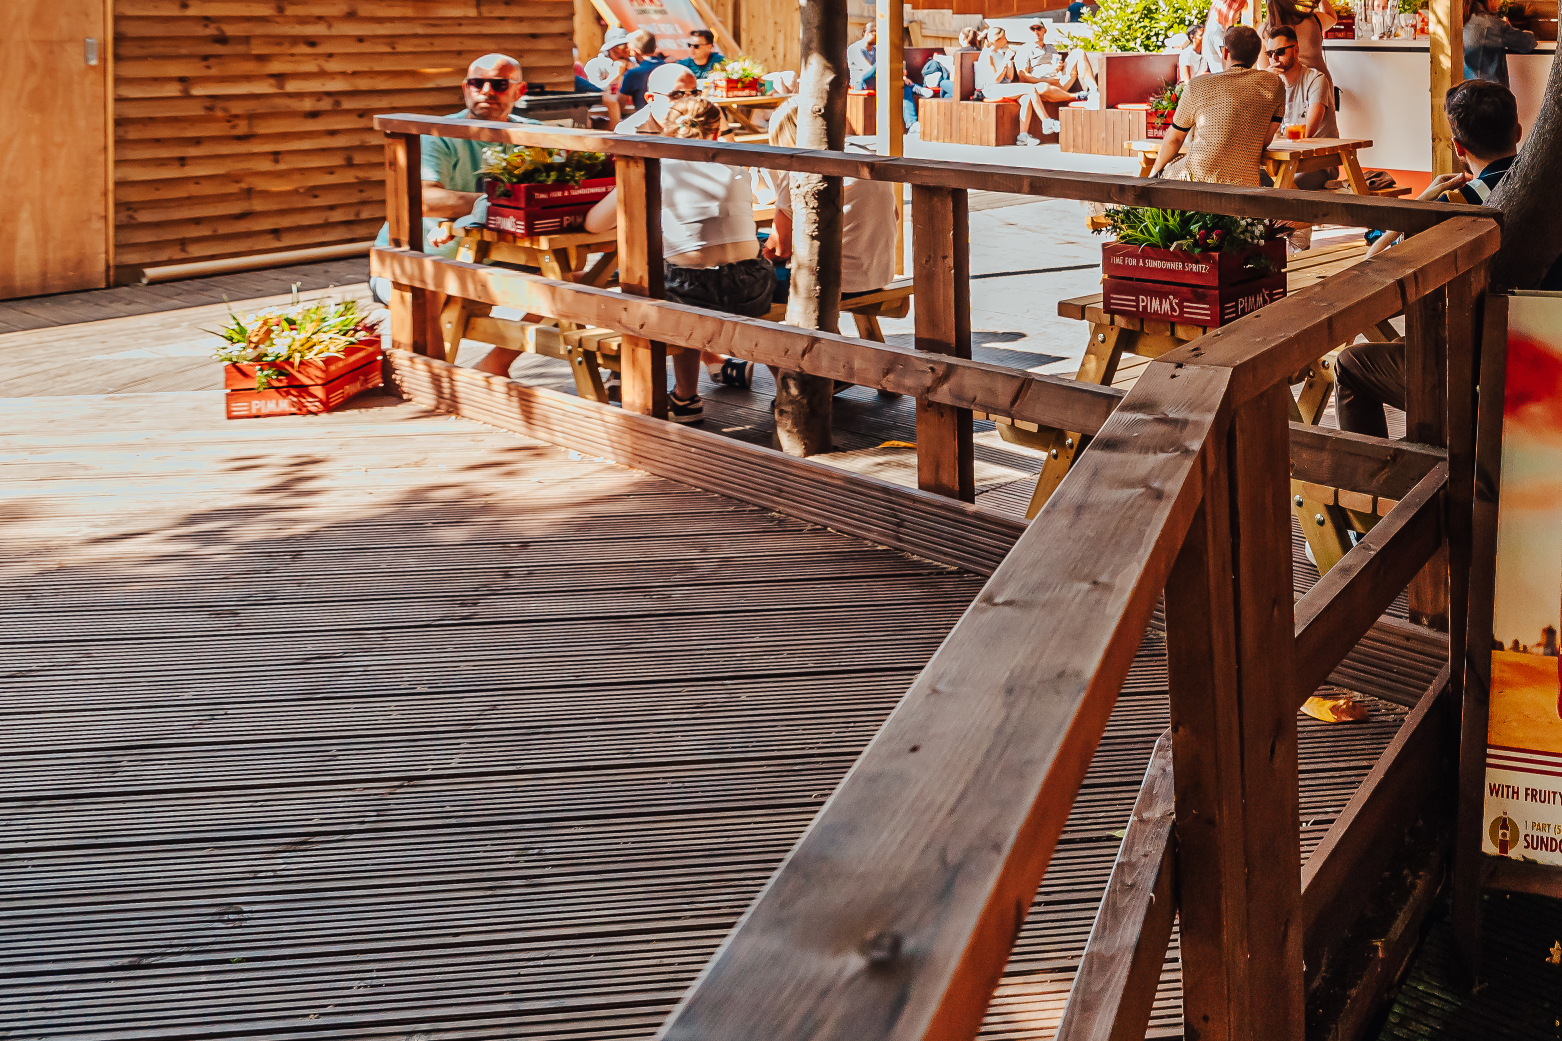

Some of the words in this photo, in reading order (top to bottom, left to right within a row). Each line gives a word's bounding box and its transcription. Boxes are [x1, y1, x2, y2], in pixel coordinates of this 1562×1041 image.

[1110, 256, 1124, 265] TIME
[1125, 257, 1137, 266] FOR
[1139, 258, 1144, 267] A
[1145, 259, 1183, 271] SUNDOWNER
[1184, 262, 1210, 274] SPRITZ?
[1139, 294, 1180, 316] PIMM'S
[1238, 287, 1270, 315] PIMM'S
[1488, 782, 1520, 801] WITH
[1524, 820, 1528, 830] 1
[1531, 821, 1551, 833] PART
